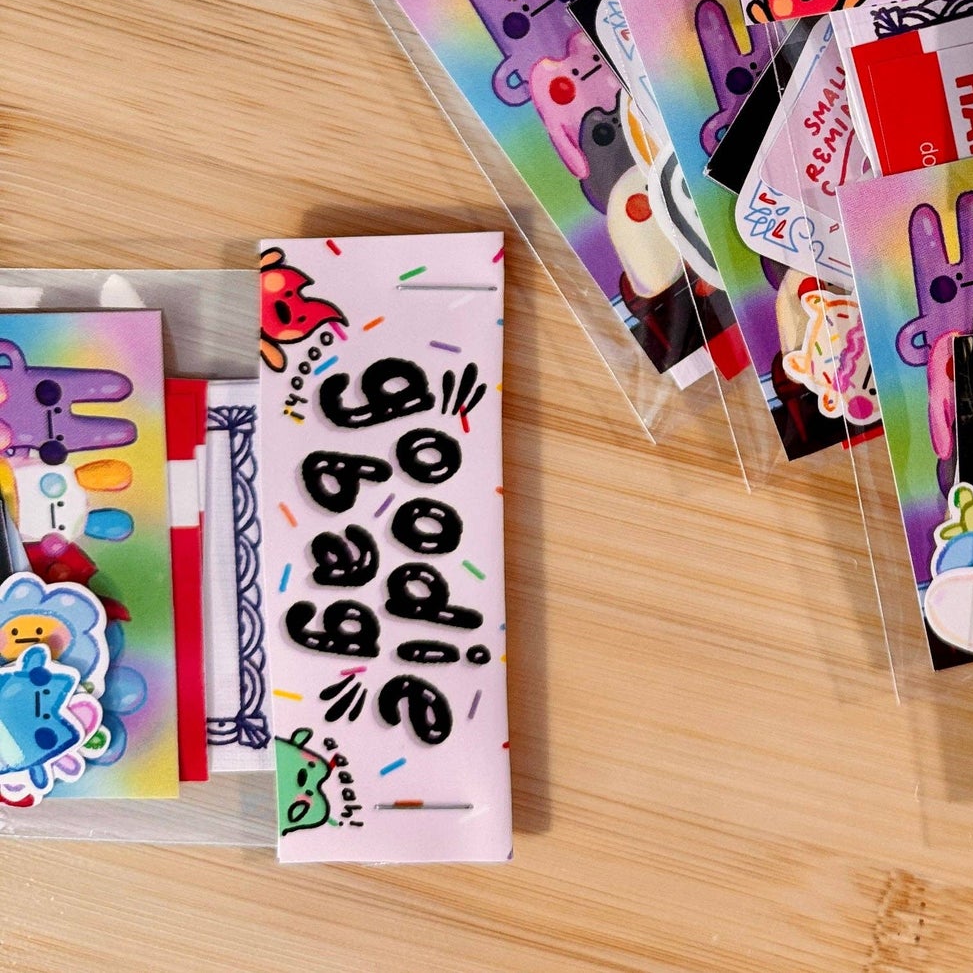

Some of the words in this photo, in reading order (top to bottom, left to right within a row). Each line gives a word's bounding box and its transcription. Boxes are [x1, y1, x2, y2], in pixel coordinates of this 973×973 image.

[918, 141, 939, 167] do
[285, 450, 393, 658] bag
[319, 357, 491, 745] goodie
